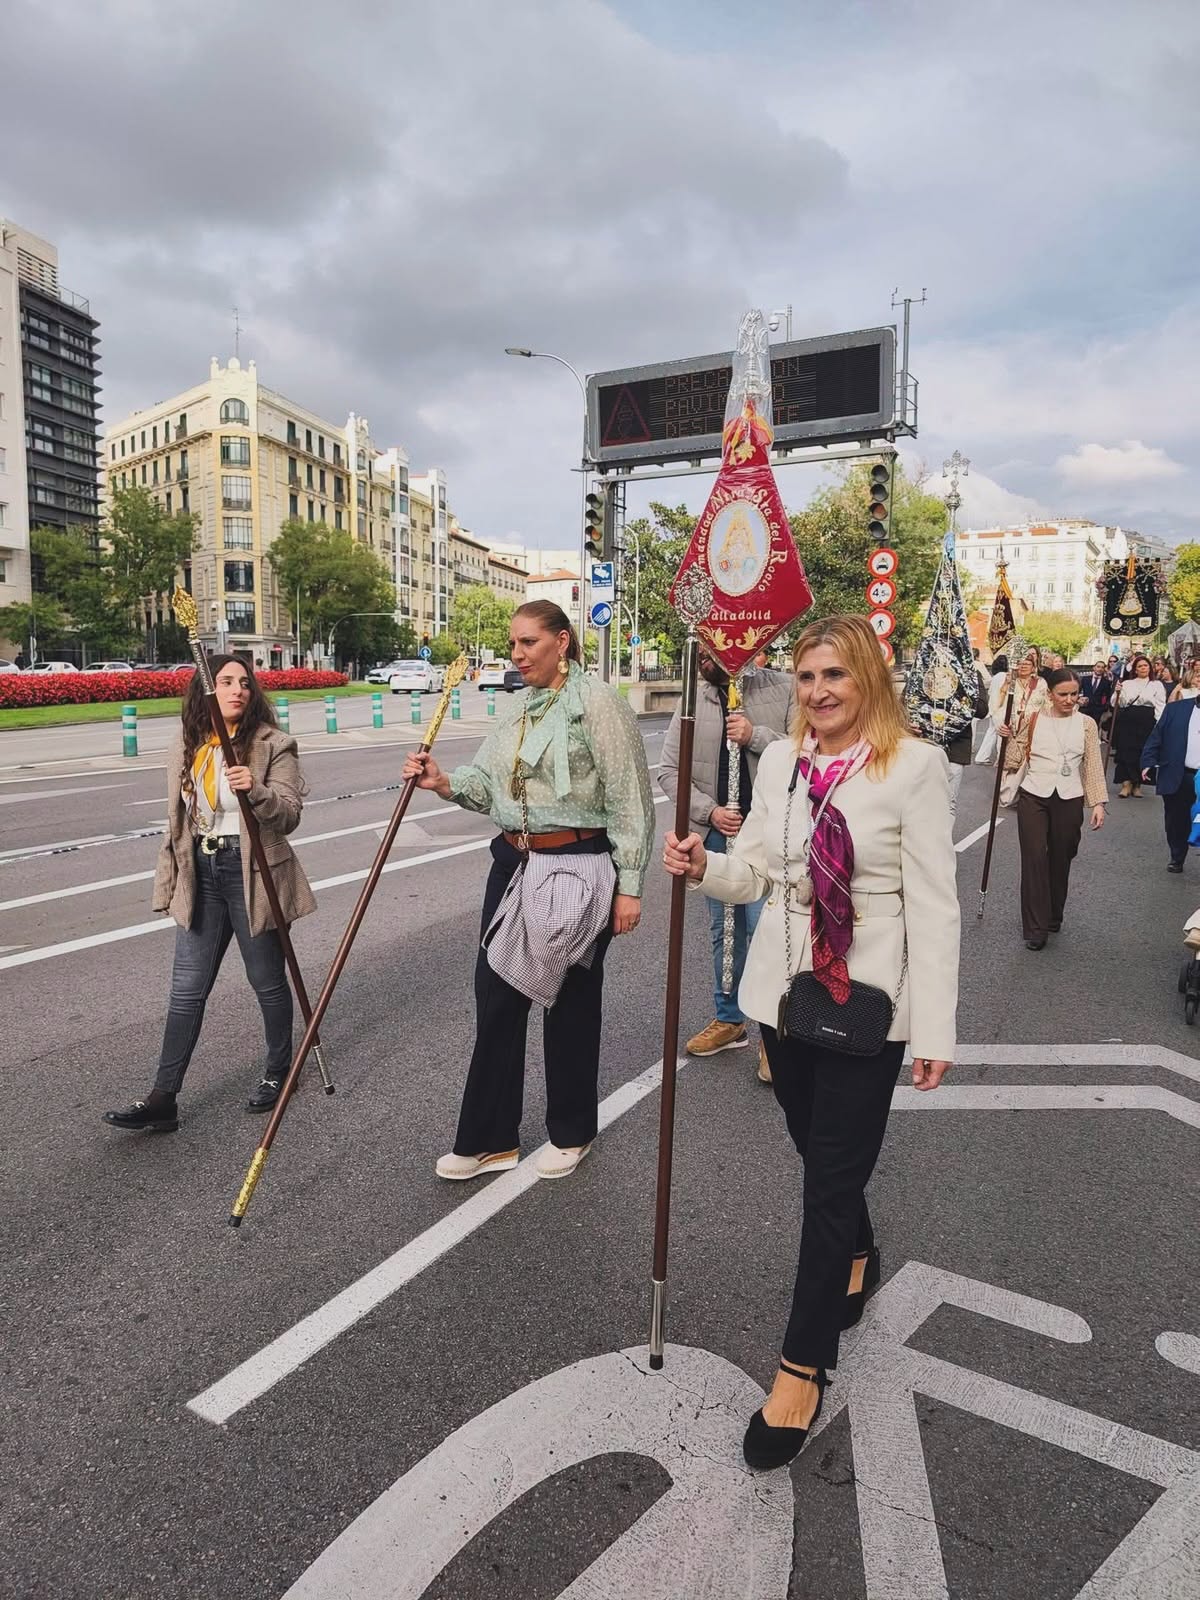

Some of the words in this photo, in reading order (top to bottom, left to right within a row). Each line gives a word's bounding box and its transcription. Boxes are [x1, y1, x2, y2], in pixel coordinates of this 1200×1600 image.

[664, 358, 800, 395] PRECAON
[665, 384, 785, 417] PAVIMO
[665, 405, 800, 439] DESLTE
[770, 522, 782, 542] del
[710, 609, 771, 621] alladolid
